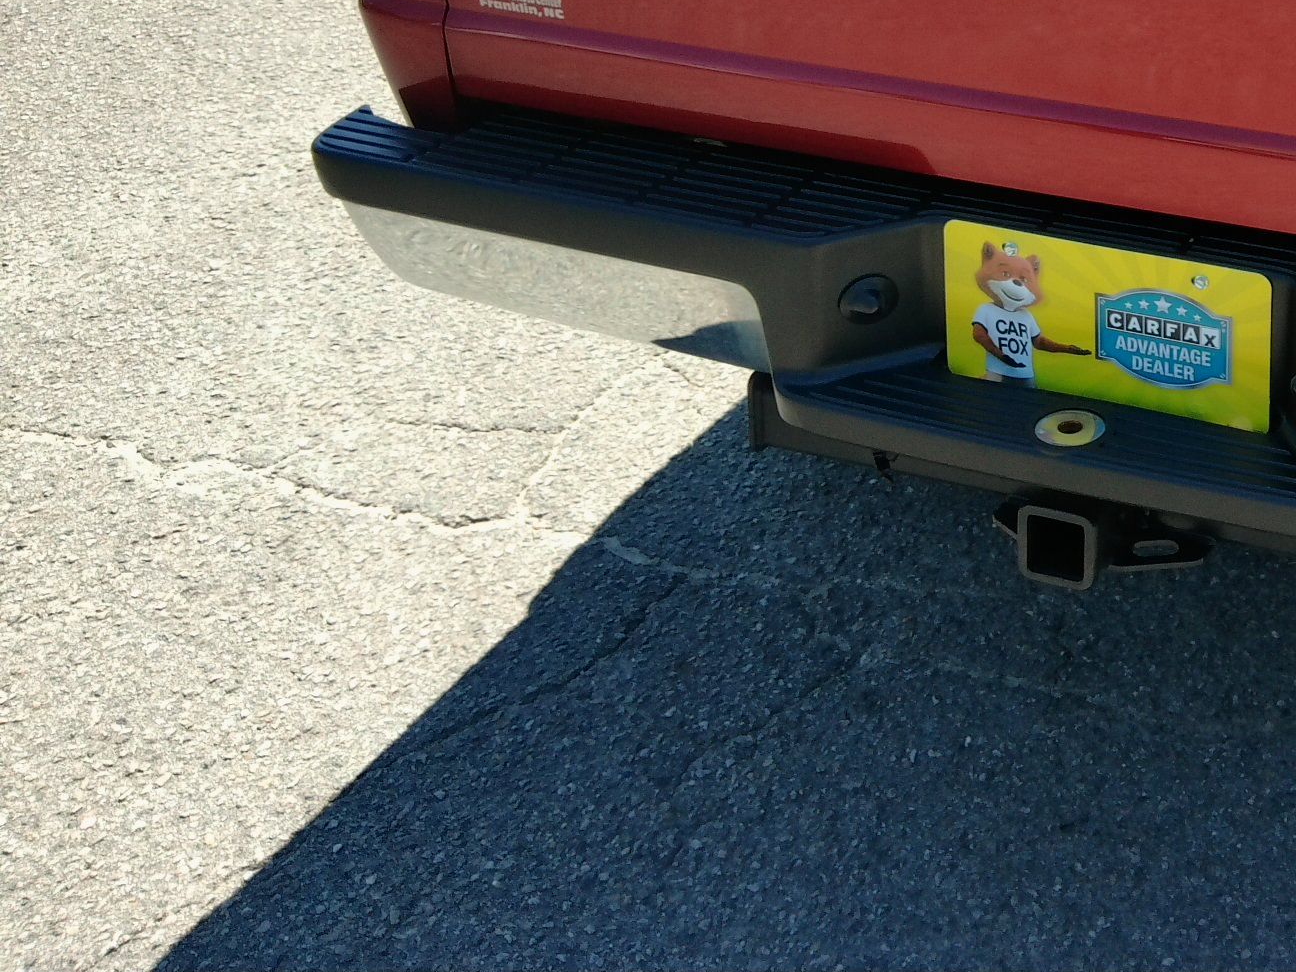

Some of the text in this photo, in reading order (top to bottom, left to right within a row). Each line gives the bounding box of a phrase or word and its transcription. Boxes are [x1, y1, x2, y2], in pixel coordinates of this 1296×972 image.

[543, 7, 565, 19] NC
[996, 319, 1029, 339] CAR
[1108, 312, 1218, 348] CARFAX
[998, 336, 1029, 357] FOX
[1115, 335, 1212, 367] ADVANTAGE
[1132, 355, 1195, 382] DEALER
